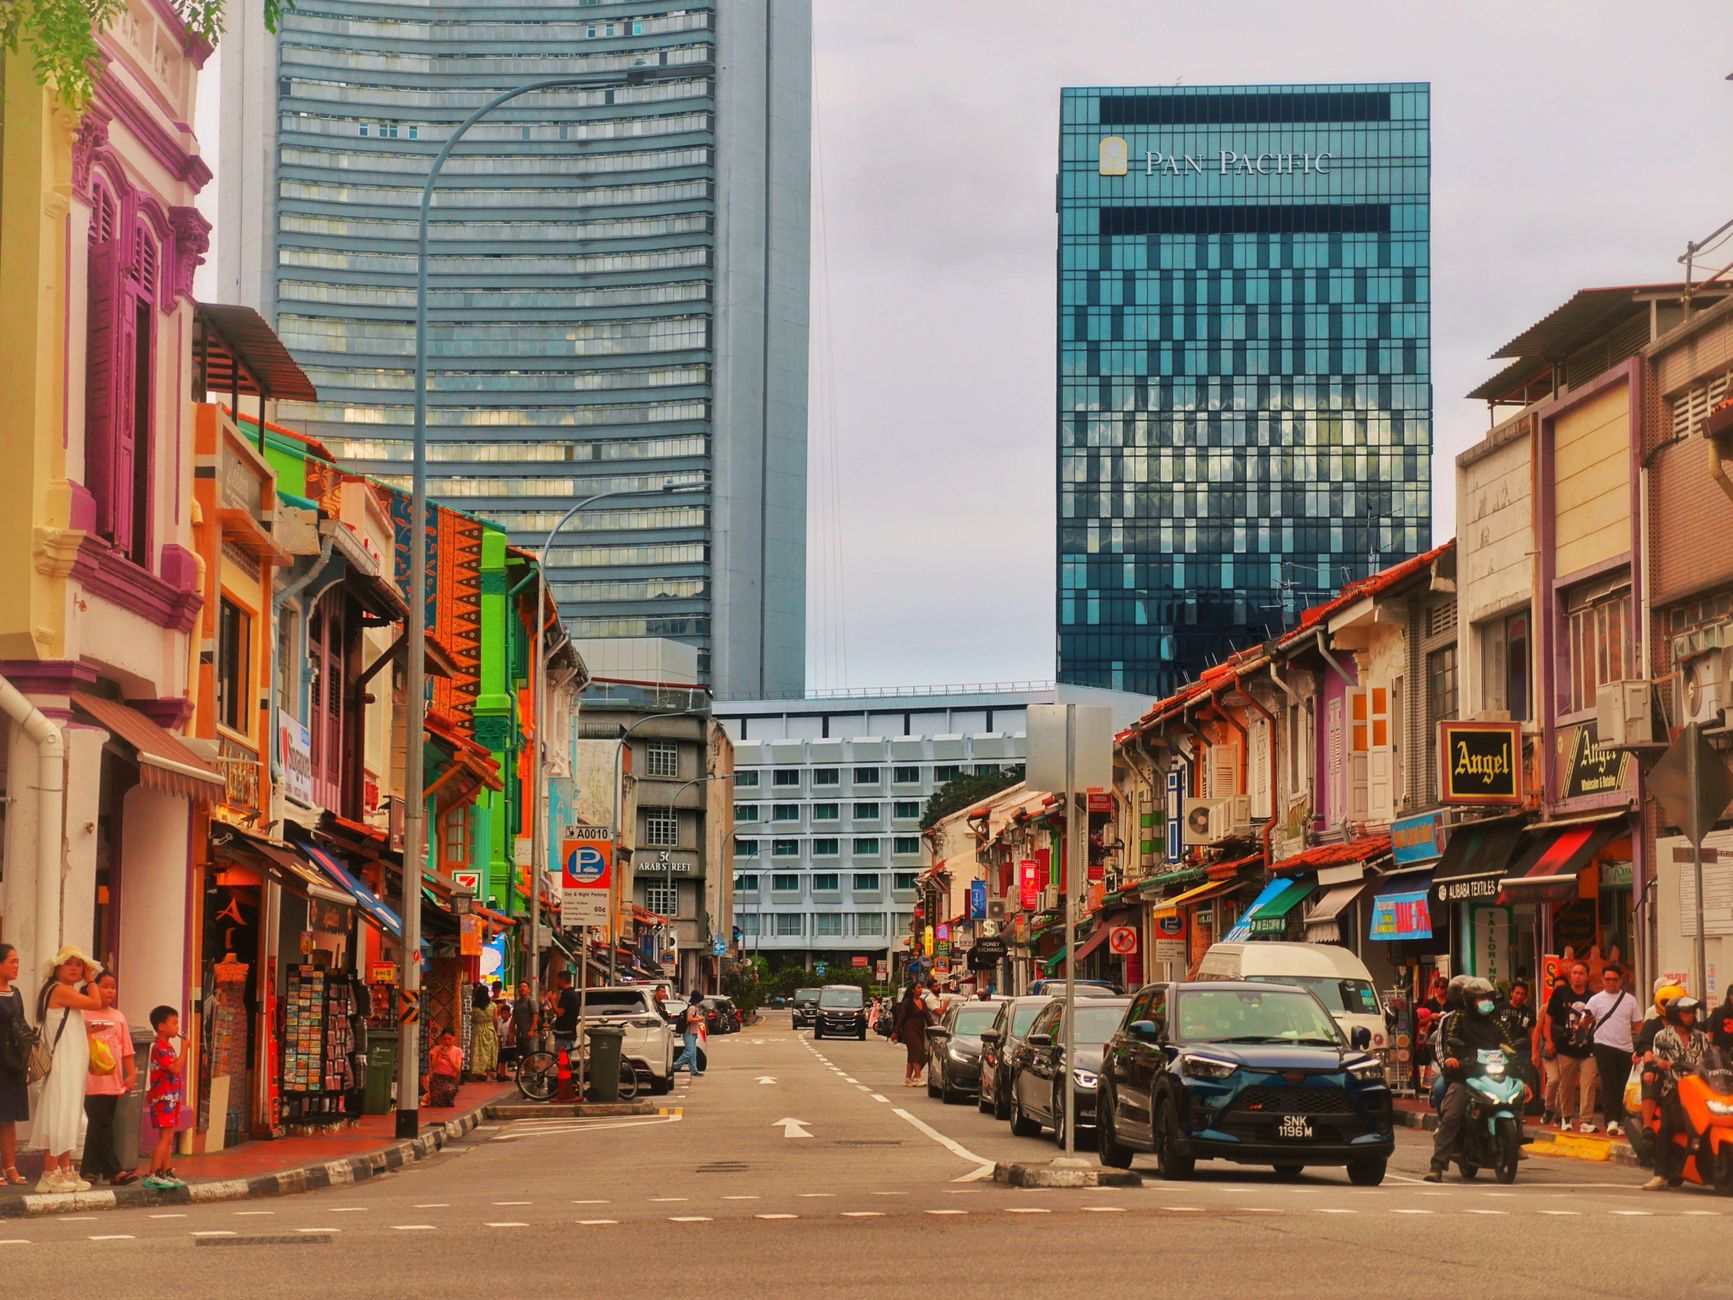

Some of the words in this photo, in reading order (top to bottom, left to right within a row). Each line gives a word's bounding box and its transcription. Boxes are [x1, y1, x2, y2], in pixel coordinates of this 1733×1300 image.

[1145, 151, 1203, 176] PAN
[1219, 150, 1332, 175] PACIFIC
[1581, 730, 1616, 774] Ange
[1455, 741, 1509, 785] Angel
[576, 829, 608, 839] A0010
[575, 849, 601, 873] P
[639, 862, 660, 871] ARAB
[662, 862, 692, 871] SREET
[1449, 882, 1470, 899] ALIBABA
[1471, 880, 1496, 896] TEXTILES
[1283, 1115, 1307, 1127] SNK
[1279, 1126, 1312, 1137] 1196M
